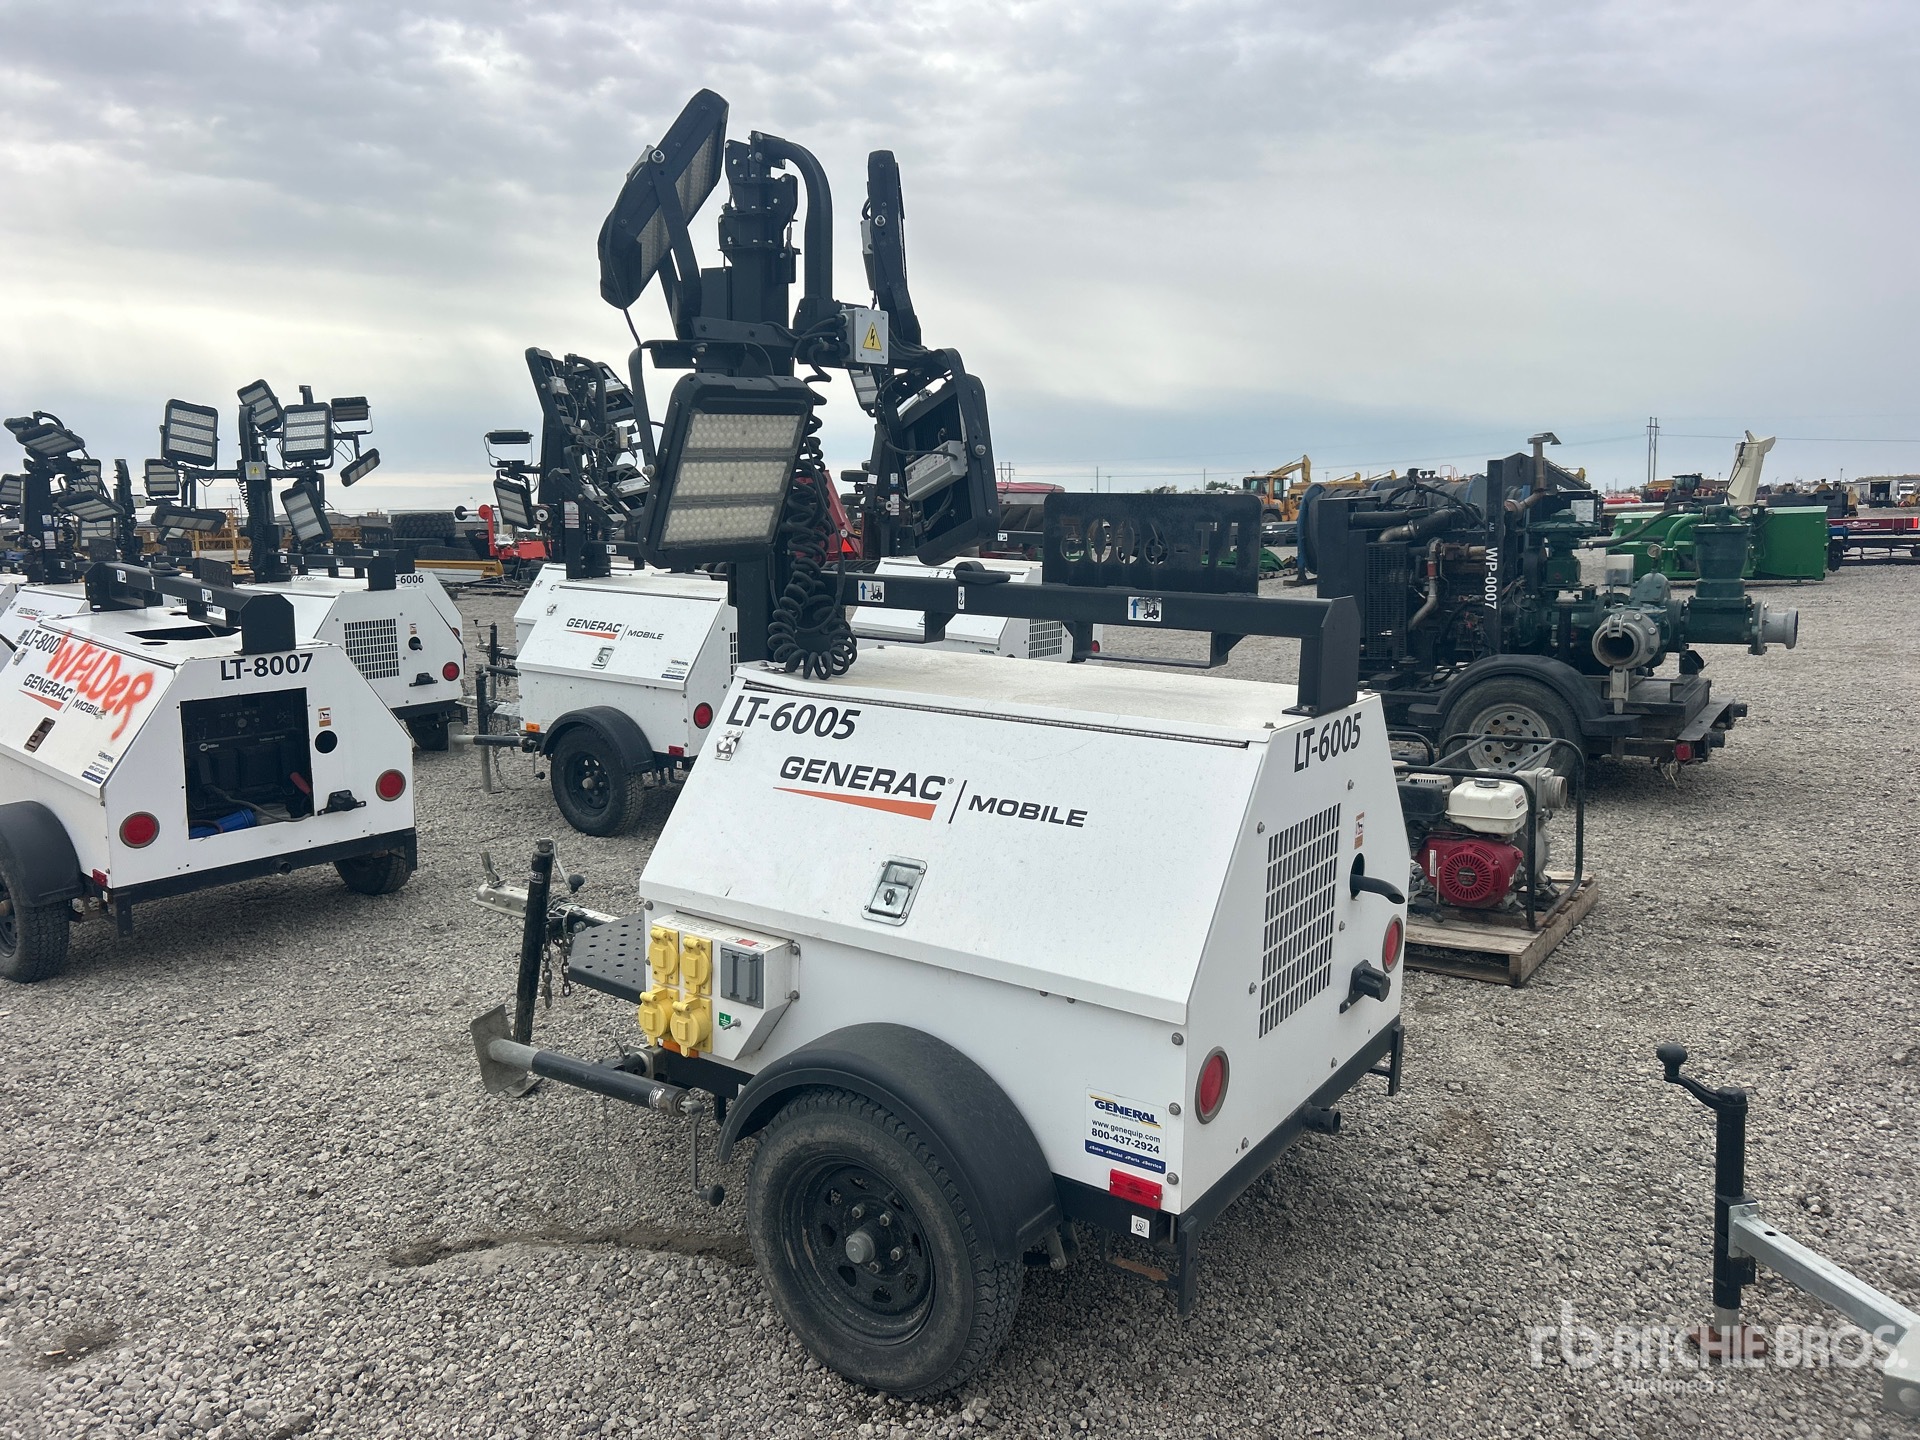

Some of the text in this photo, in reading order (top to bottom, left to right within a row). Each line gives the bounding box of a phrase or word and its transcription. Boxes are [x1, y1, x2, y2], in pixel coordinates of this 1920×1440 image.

[394, 575, 424, 584] -6006
[1484, 547, 1498, 610] WP-0007
[23, 628, 64, 656] LT-800
[566, 618, 665, 641] GENERAC MOBILE
[219, 652, 314, 683] LT-8007
[23, 673, 74, 702] GENERAC
[725, 695, 862, 740] LT-6005
[1293, 712, 1363, 773] LT-6005
[779, 755, 1089, 829] GENERAC MOBILE
[1094, 1100, 1158, 1124] GENERAL
[1091, 1119, 1161, 1144] www.genequip.com
[1091, 1127, 1160, 1155] 800-437-2924
[1108, 1149, 1123, 1158] Rental
[1127, 1155, 1140, 1163] Parts
[1145, 1160, 1162, 1170] Service
